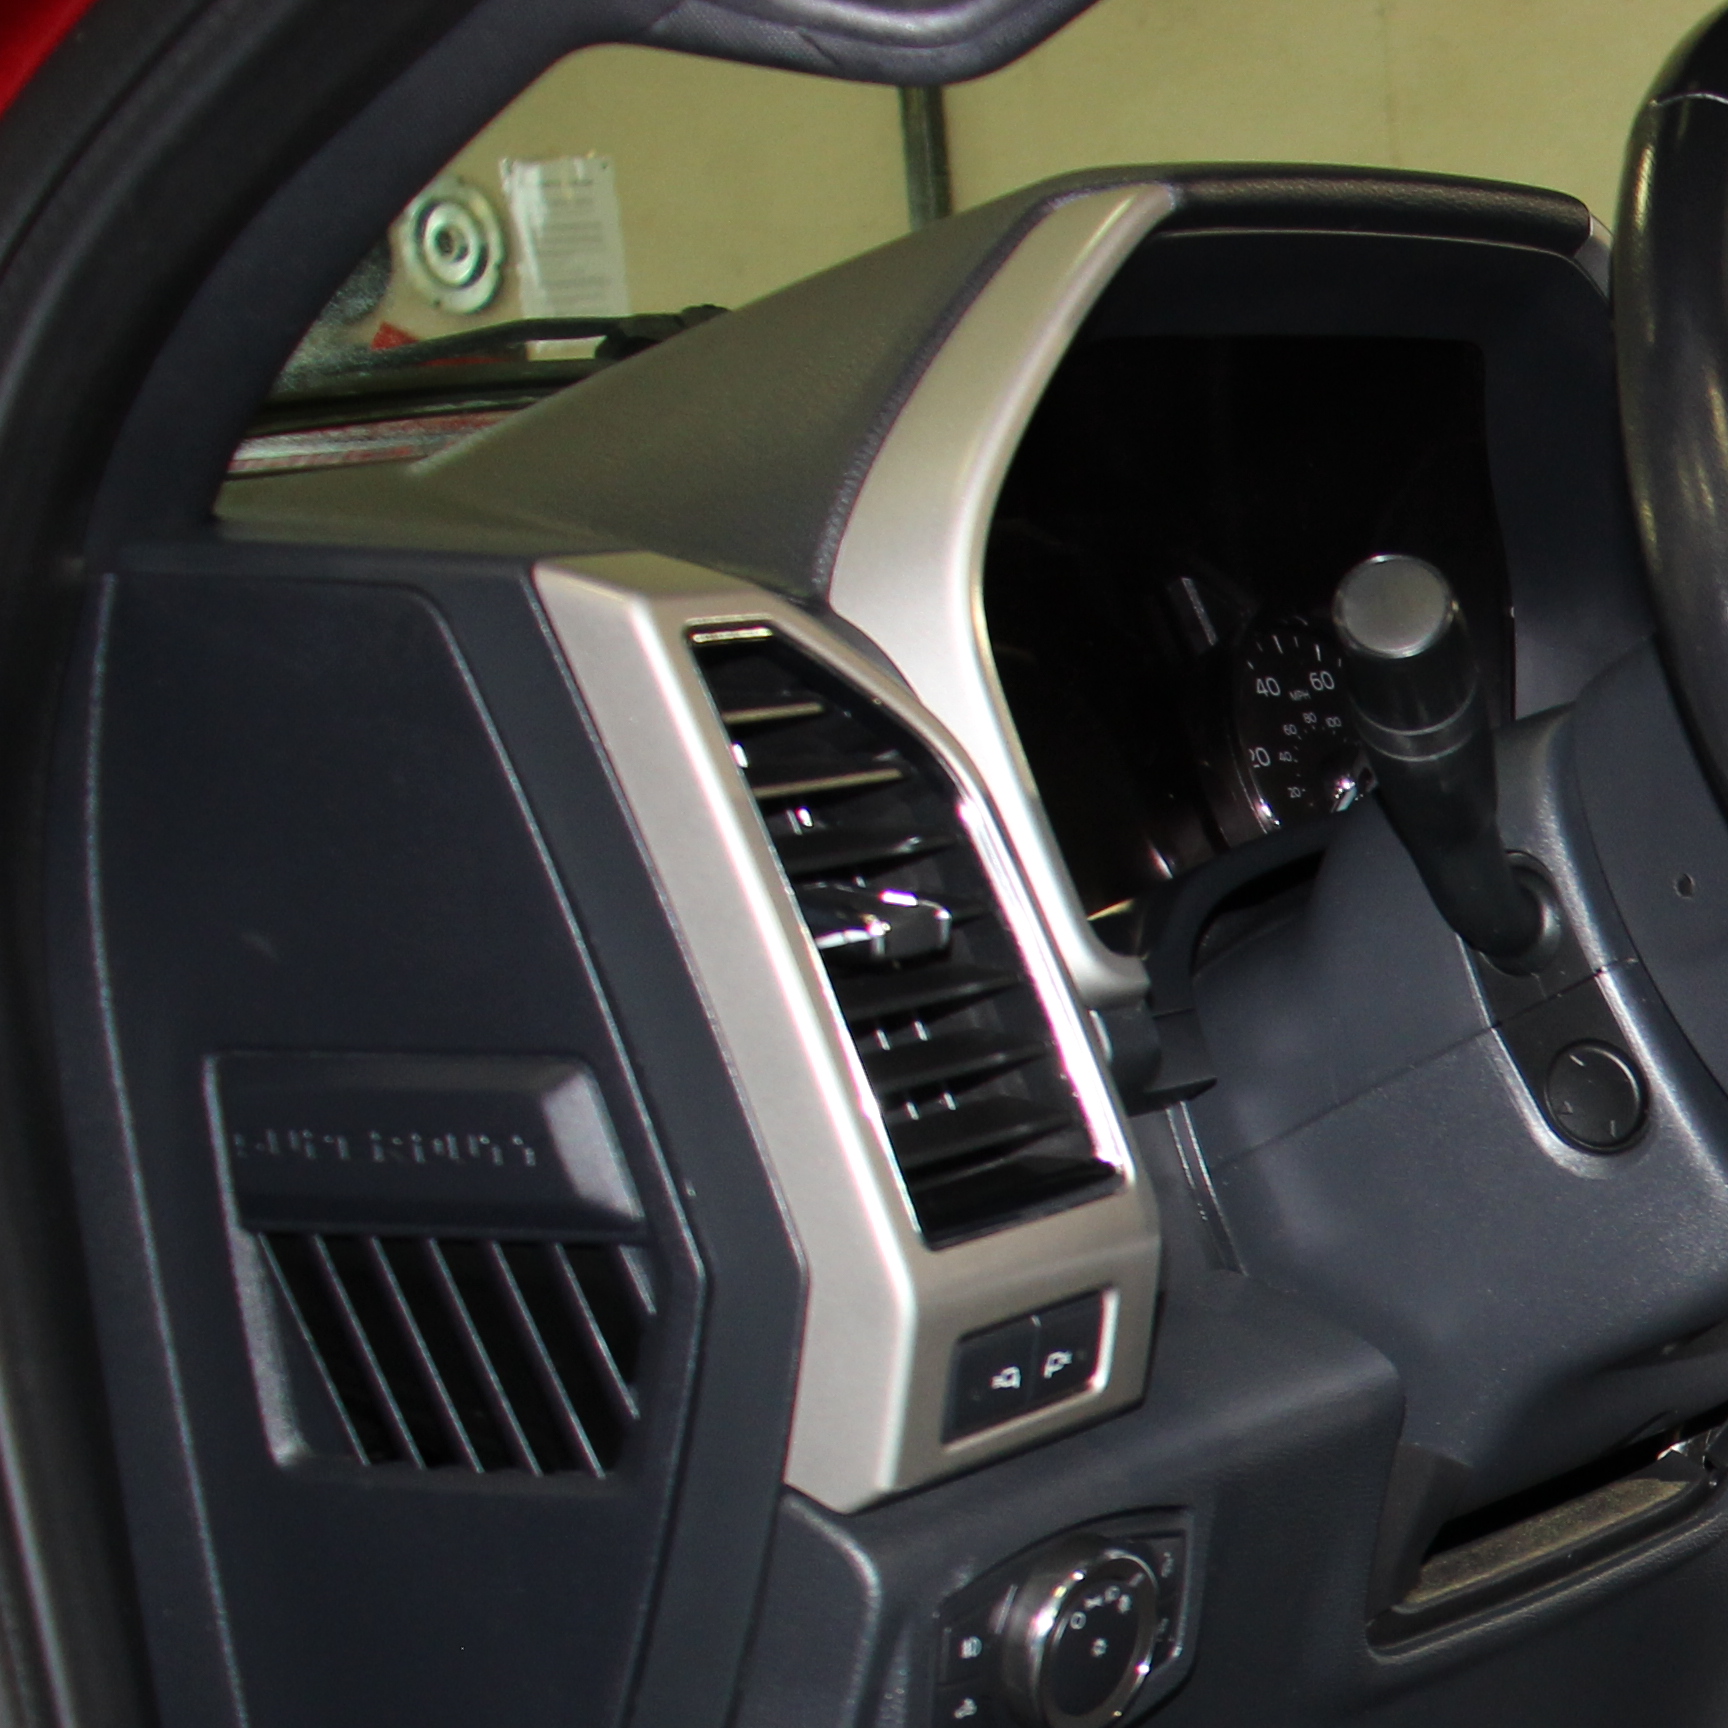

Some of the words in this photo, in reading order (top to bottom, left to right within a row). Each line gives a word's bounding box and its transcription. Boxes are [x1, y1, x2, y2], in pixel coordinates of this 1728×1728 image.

[1256, 677, 1281, 697] 40
[1309, 670, 1335, 691] 60
[1289, 689, 1312, 701] MPH
[1302, 711, 1317, 724] 80
[1325, 716, 1342, 728] 100
[1282, 723, 1298, 736] 60
[1279, 751, 1293, 763] 40
[1287, 786, 1301, 799] 20
